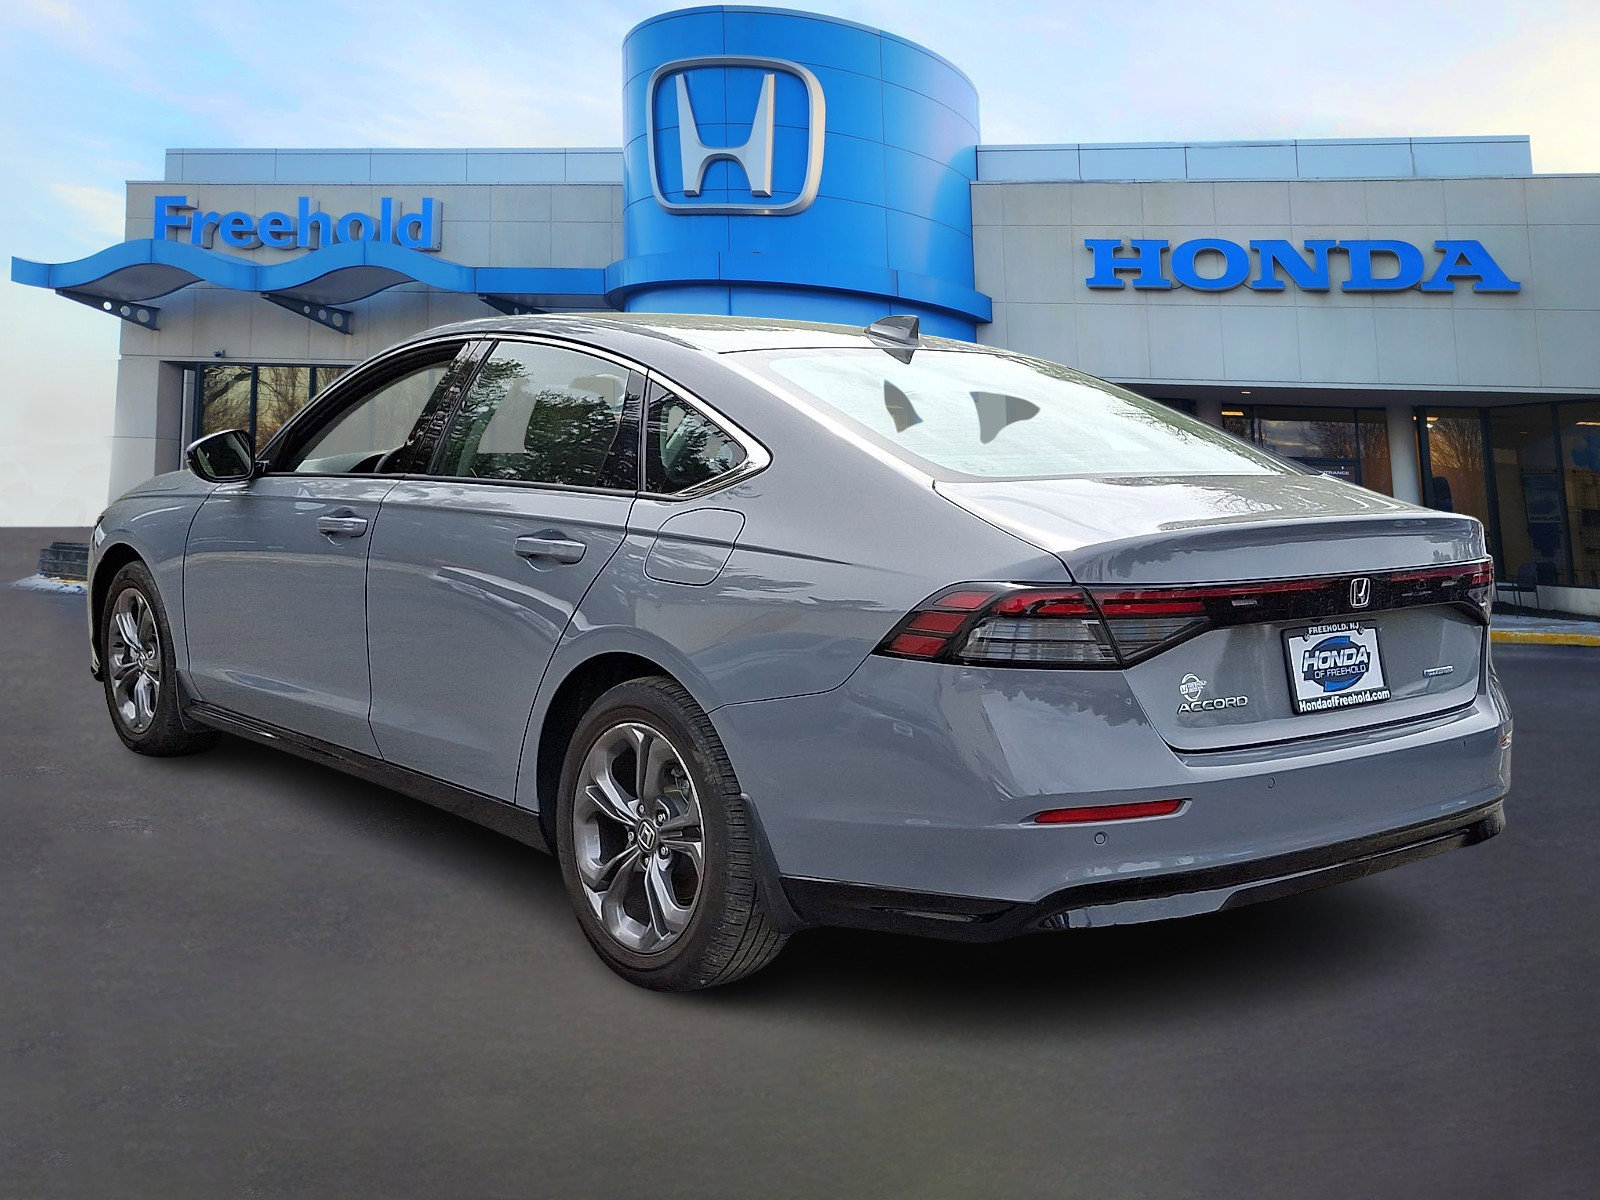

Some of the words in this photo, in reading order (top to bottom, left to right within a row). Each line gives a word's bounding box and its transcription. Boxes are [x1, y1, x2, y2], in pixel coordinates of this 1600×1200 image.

[154, 195, 437, 250] Freehold
[1084, 238, 1522, 293] HONDA
[1350, 621, 1360, 630] NJ
[1303, 646, 1369, 672] HONDA
[1314, 669, 1326, 679] OF
[1326, 664, 1367, 677] FREEHOLD
[1177, 695, 1249, 714] ACCORD
[1299, 690, 1391, 713] HondaofFreehold.com
